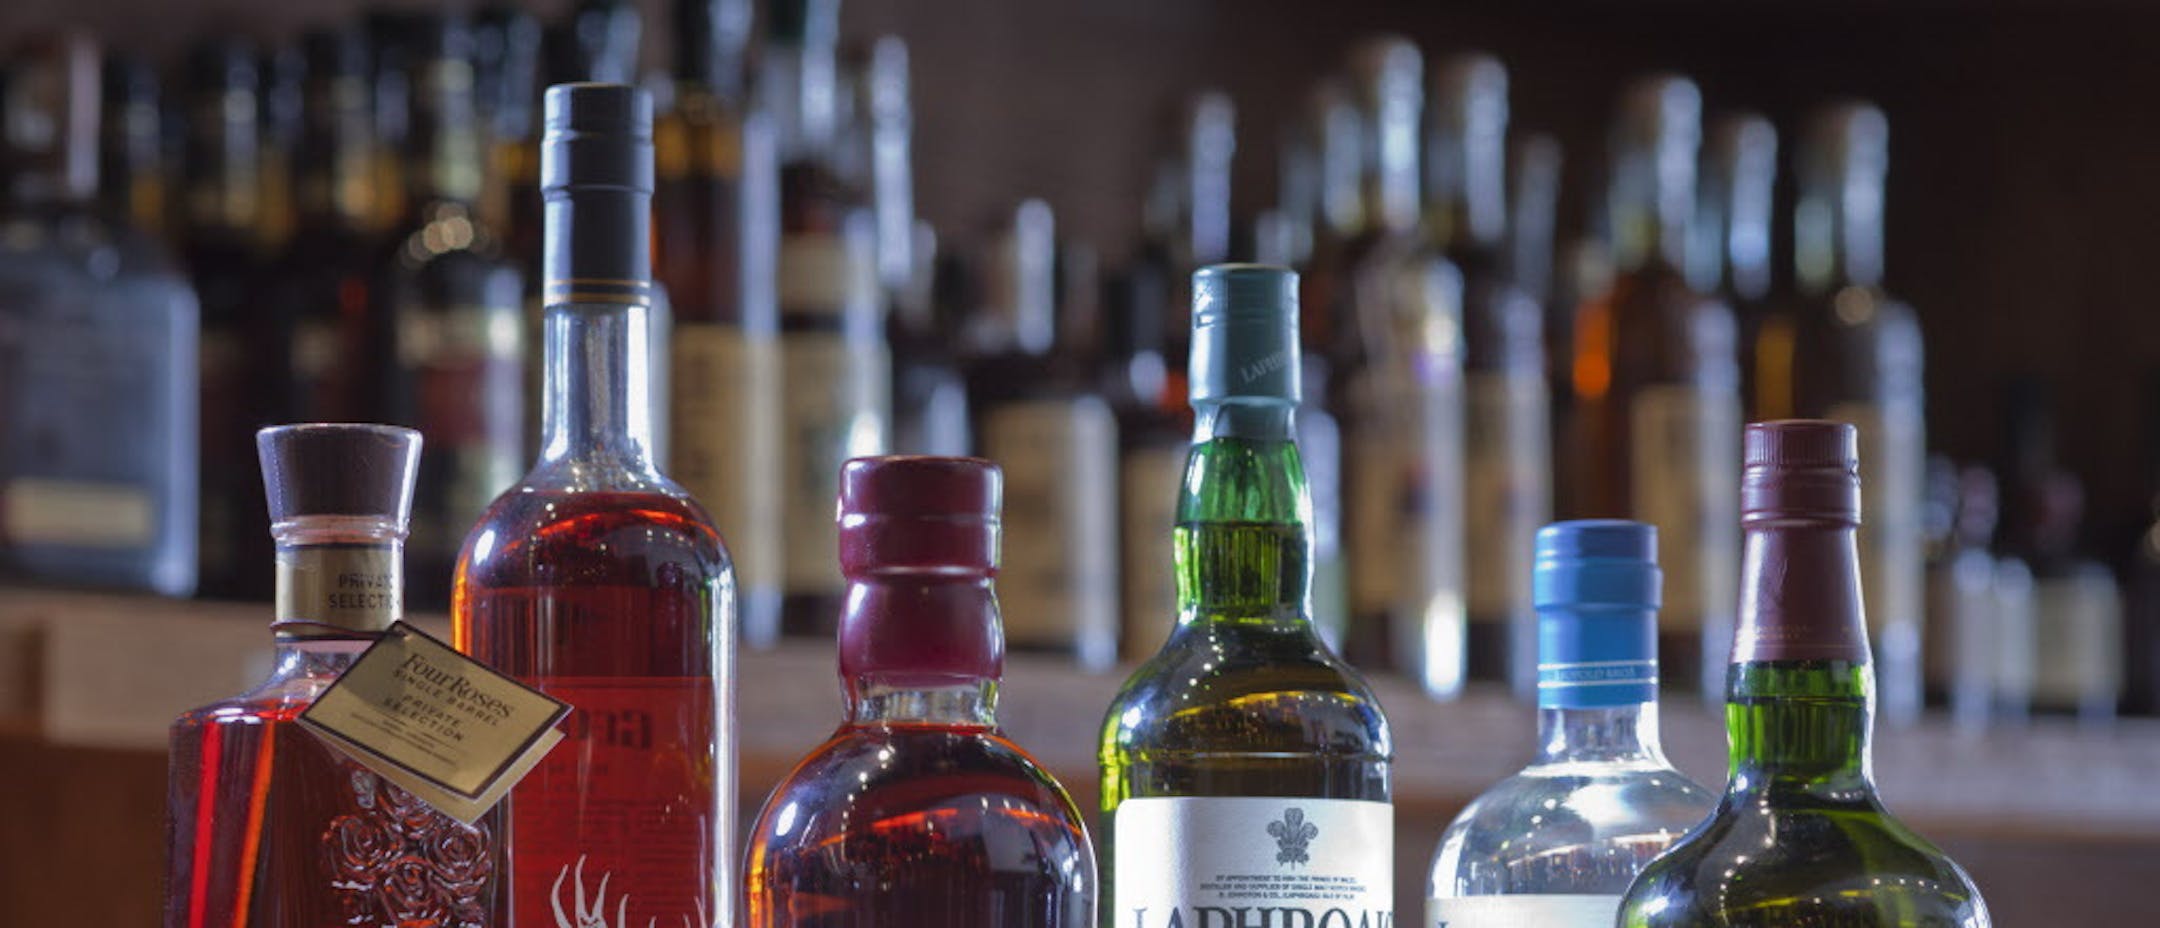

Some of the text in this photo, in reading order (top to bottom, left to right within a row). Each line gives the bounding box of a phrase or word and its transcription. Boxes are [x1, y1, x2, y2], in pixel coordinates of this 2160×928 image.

[392, 668, 498, 727] SINGLE BARREL
[402, 653, 514, 718] Four Roses
[402, 694, 461, 729] PRIVATE
[383, 697, 465, 742] SELECTION
